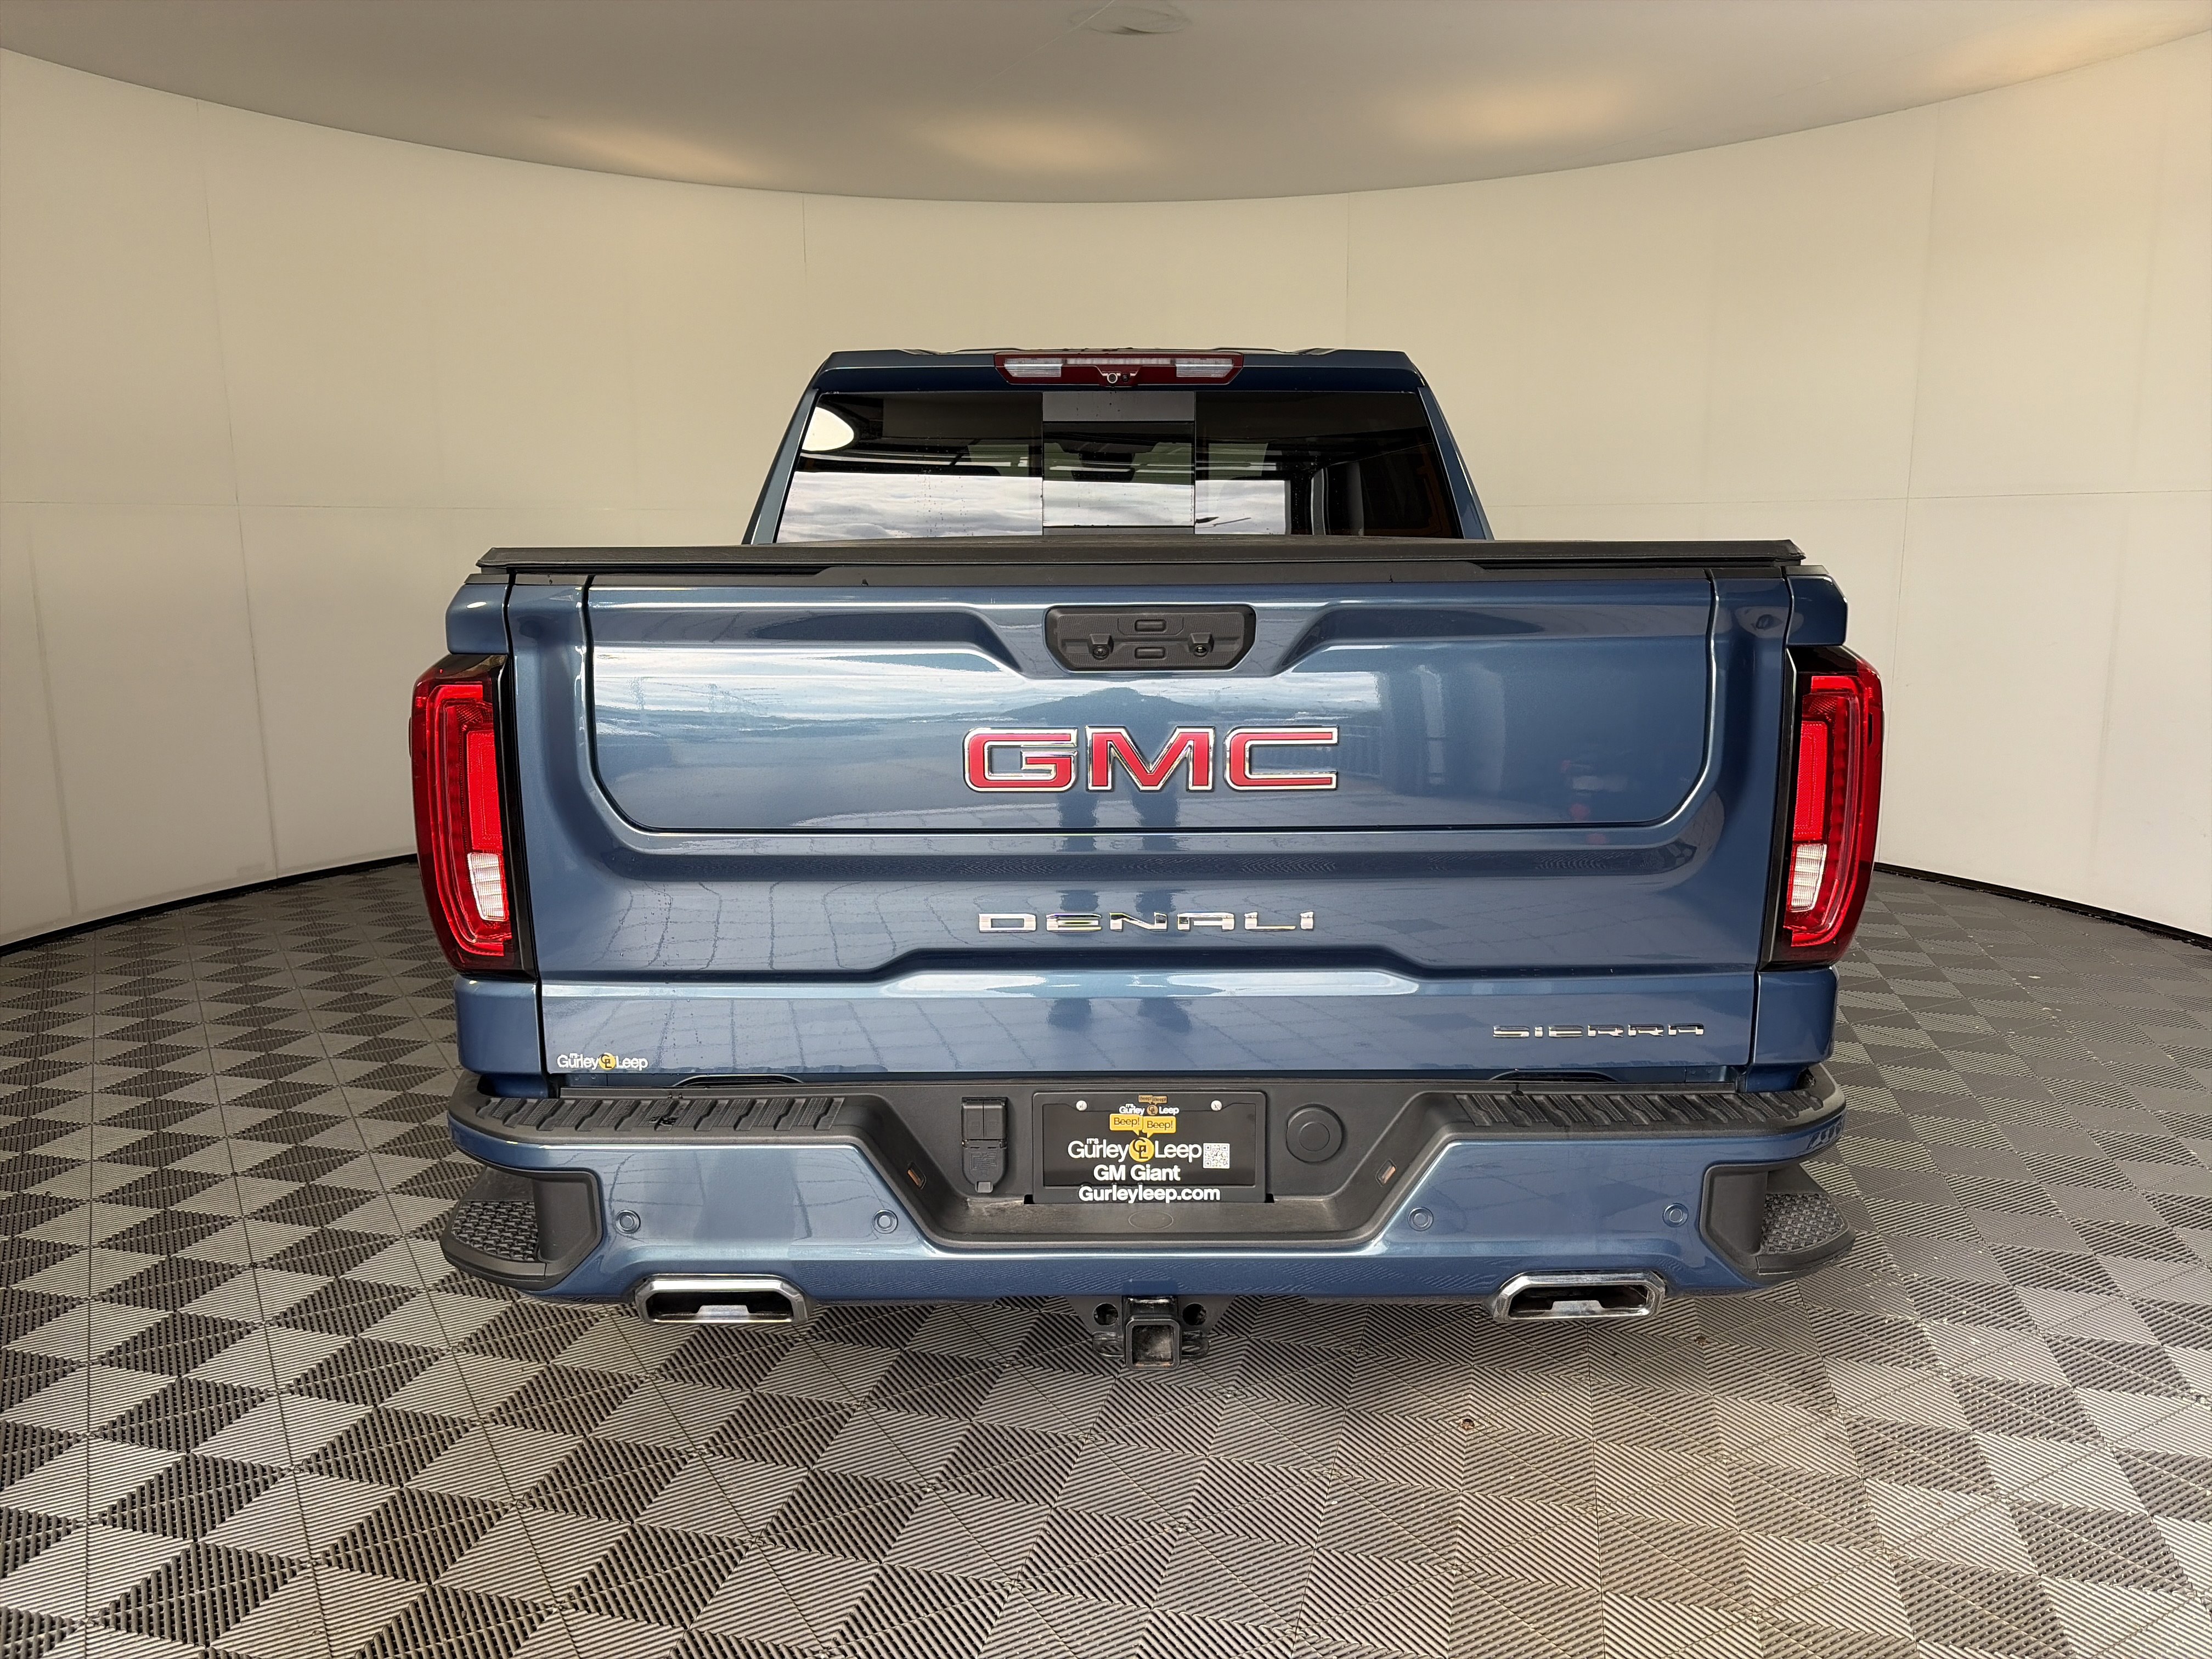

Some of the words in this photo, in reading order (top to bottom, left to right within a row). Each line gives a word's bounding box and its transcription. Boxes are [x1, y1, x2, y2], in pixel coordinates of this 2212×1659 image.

[963, 725, 1339, 792] GMC
[978, 911, 1315, 932] DENALI
[1493, 1023, 1704, 1038] SIERRA
[557, 1054, 599, 1070] Gurley
[616, 1056, 648, 1071] Leep
[1119, 1105, 1145, 1115] Gurley
[1159, 1107, 1179, 1115] Leep
[1114, 1117, 1139, 1127] Beep!
[1147, 1120, 1173, 1130] Beep!
[1068, 1139, 1129, 1163] Gurley
[1155, 1141, 1201, 1163] Leep
[1093, 1164, 1125, 1181] GM
[1131, 1164, 1181, 1181] Giant
[1079, 1184, 1221, 1203] Gurleyleep.com
